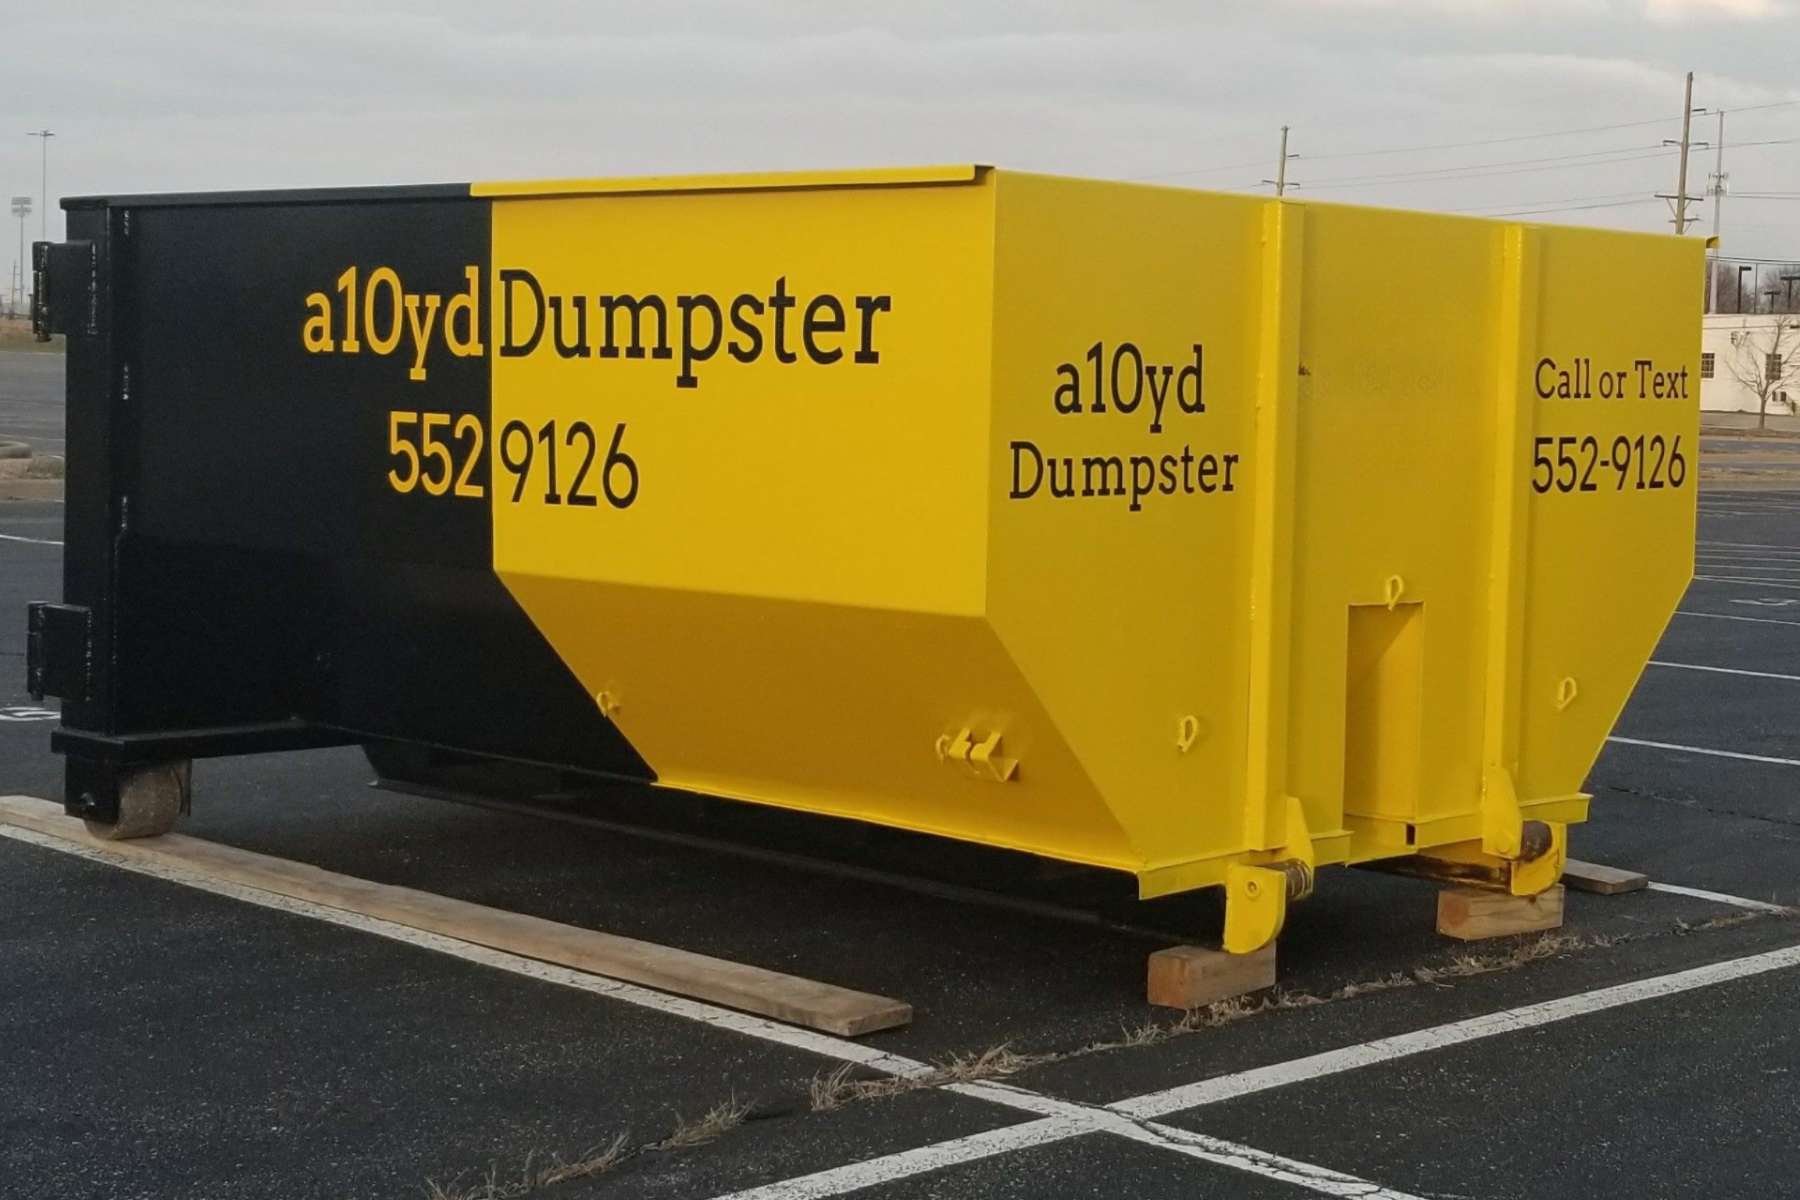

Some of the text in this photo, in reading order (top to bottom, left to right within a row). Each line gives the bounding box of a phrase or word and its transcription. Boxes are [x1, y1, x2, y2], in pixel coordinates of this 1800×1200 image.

[303, 265, 892, 389] a10yd Dumpster
[1054, 341, 1205, 434] a10yd
[1535, 357, 1689, 399] Call or Text
[388, 411, 639, 509] 552 9126
[1009, 440, 1239, 512] Dumpster
[1532, 434, 1686, 494] 552-9126
